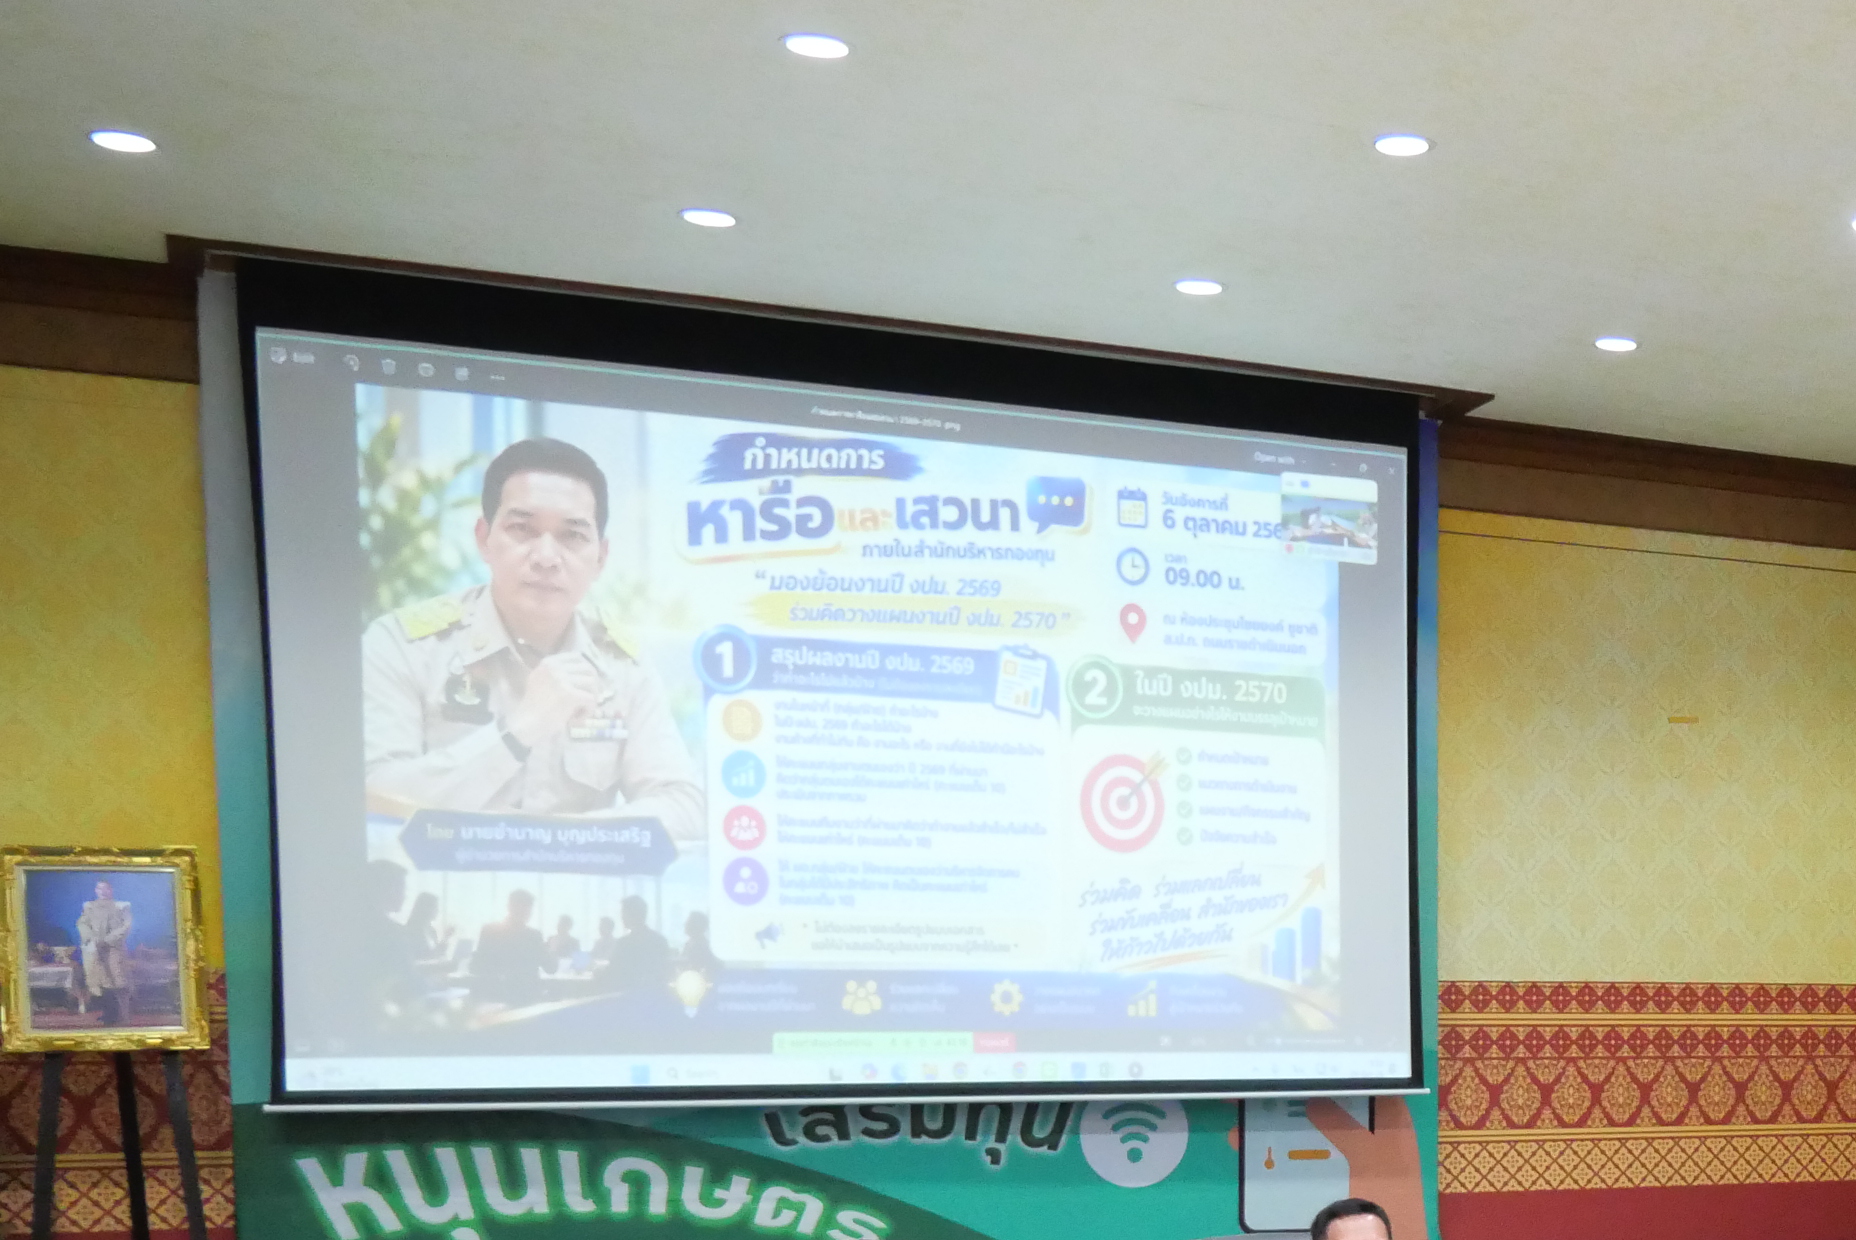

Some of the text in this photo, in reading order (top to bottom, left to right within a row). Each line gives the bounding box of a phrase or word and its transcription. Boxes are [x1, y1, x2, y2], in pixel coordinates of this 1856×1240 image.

[743, 437, 885, 471] กำหนดการ
[687, 478, 835, 547] หารือ
[895, 495, 1021, 534] เสวนา
[1162, 510, 1283, 540] 6 ตุลาคม 256
[861, 538, 1056, 567] ภายในสำนักบริหารกองทุน
[956, 578, 1002, 598] 2569
[1165, 567, 1245, 591] 09.00 น.
[715, 640, 734, 680] 1
[771, 644, 880, 674] สรุปผลงานปี
[930, 654, 975, 677] 2569
[1083, 668, 1108, 705] 2
[1135, 670, 1288, 704] ในปี งปม. 2570
[763, 1101, 1071, 1166] เสรมทุน
